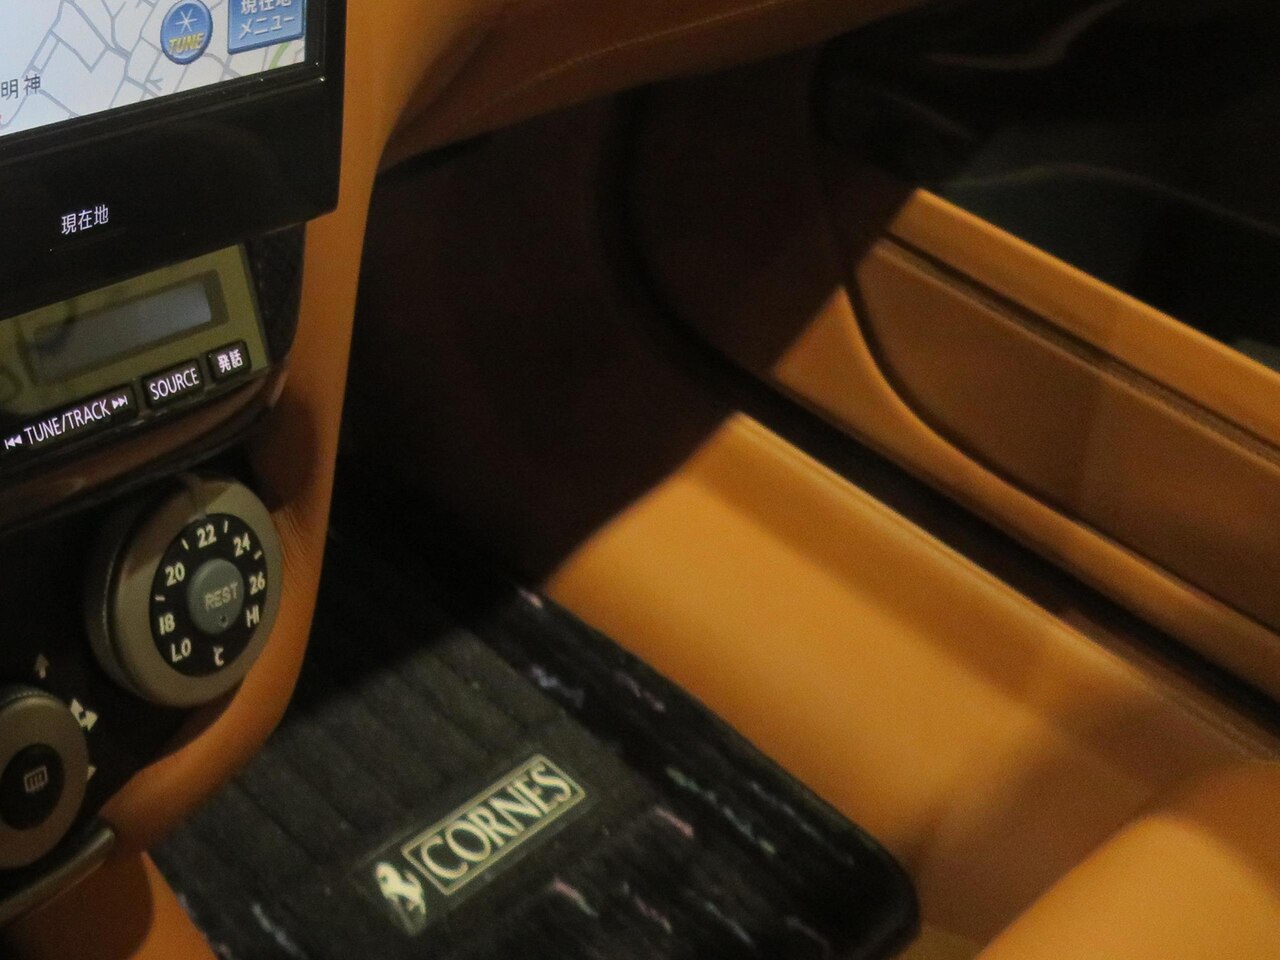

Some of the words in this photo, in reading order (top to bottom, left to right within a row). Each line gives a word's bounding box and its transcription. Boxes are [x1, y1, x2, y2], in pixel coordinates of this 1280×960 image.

[238, 14, 295, 40] メニュー
[60, 204, 110, 235] 現在地
[217, 349, 244, 373] 発話
[149, 367, 200, 401] SOURCE
[24, 398, 111, 446] TUNE/TRACK
[196, 523, 217, 548] 22
[233, 532, 251, 557] 24
[164, 561, 186, 587] 20
[248, 571, 266, 596] 26
[204, 581, 239, 612] REST
[158, 613, 176, 636] 18
[245, 605, 260, 628] HI
[170, 638, 192, 664] LO
[420, 764, 572, 880] CORNES
